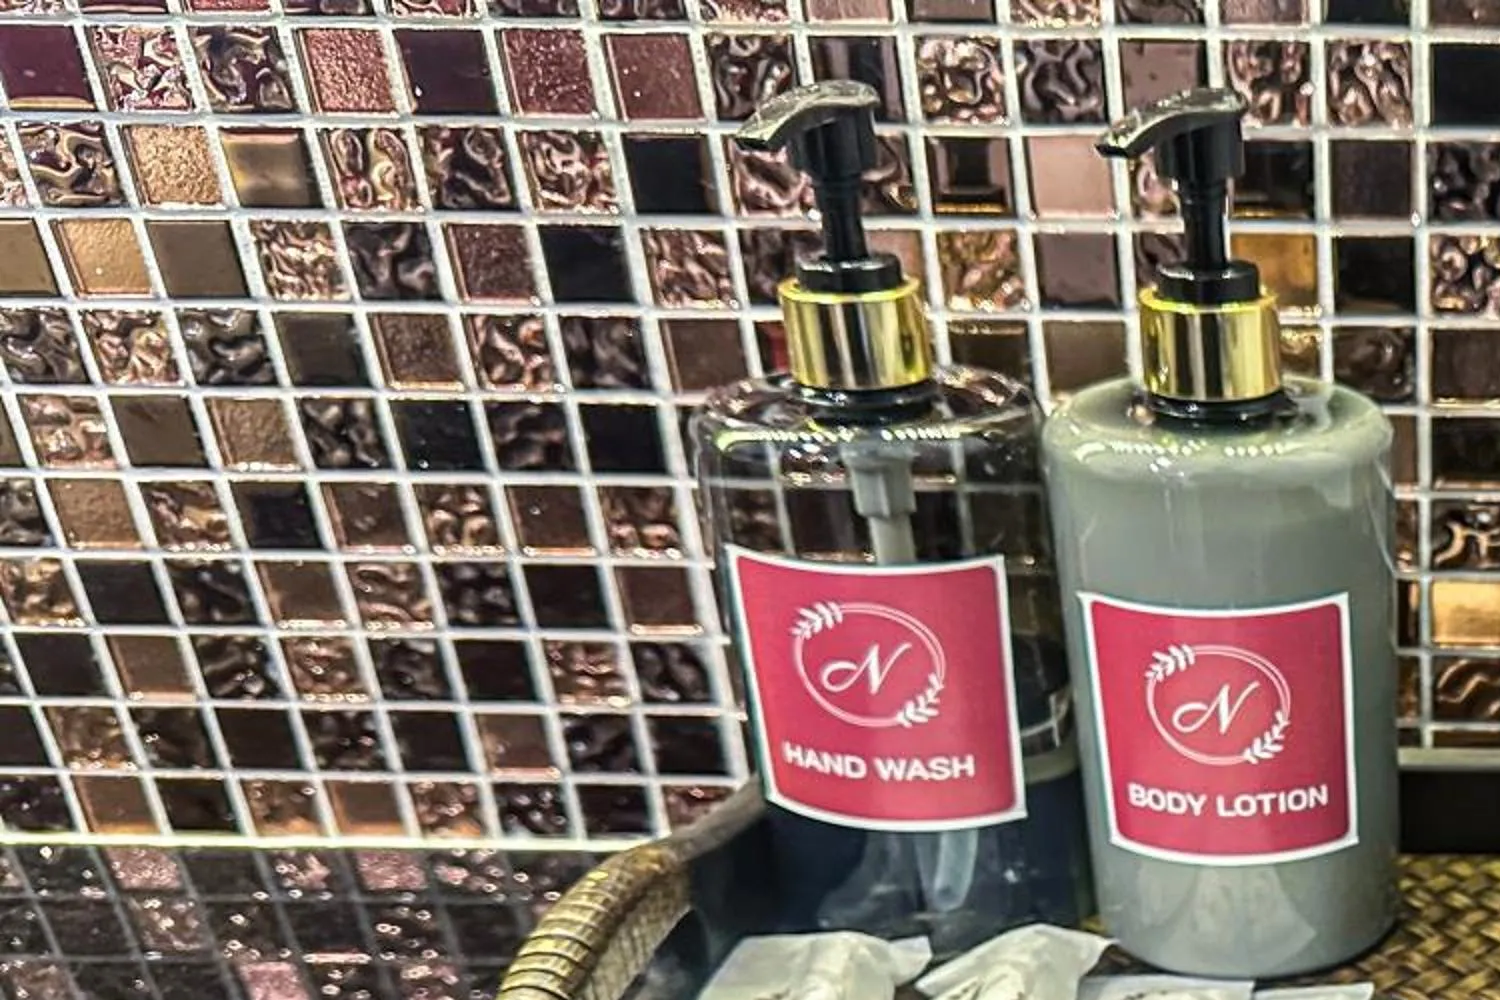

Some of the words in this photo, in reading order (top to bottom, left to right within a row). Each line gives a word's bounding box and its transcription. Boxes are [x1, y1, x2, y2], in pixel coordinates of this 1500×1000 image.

[820, 642, 912, 695] N
[1171, 681, 1260, 735] N
[782, 741, 867, 780] HAND
[874, 755, 976, 782] WASH
[1127, 782, 1206, 816] BODY
[1214, 784, 1329, 817] LOTION
